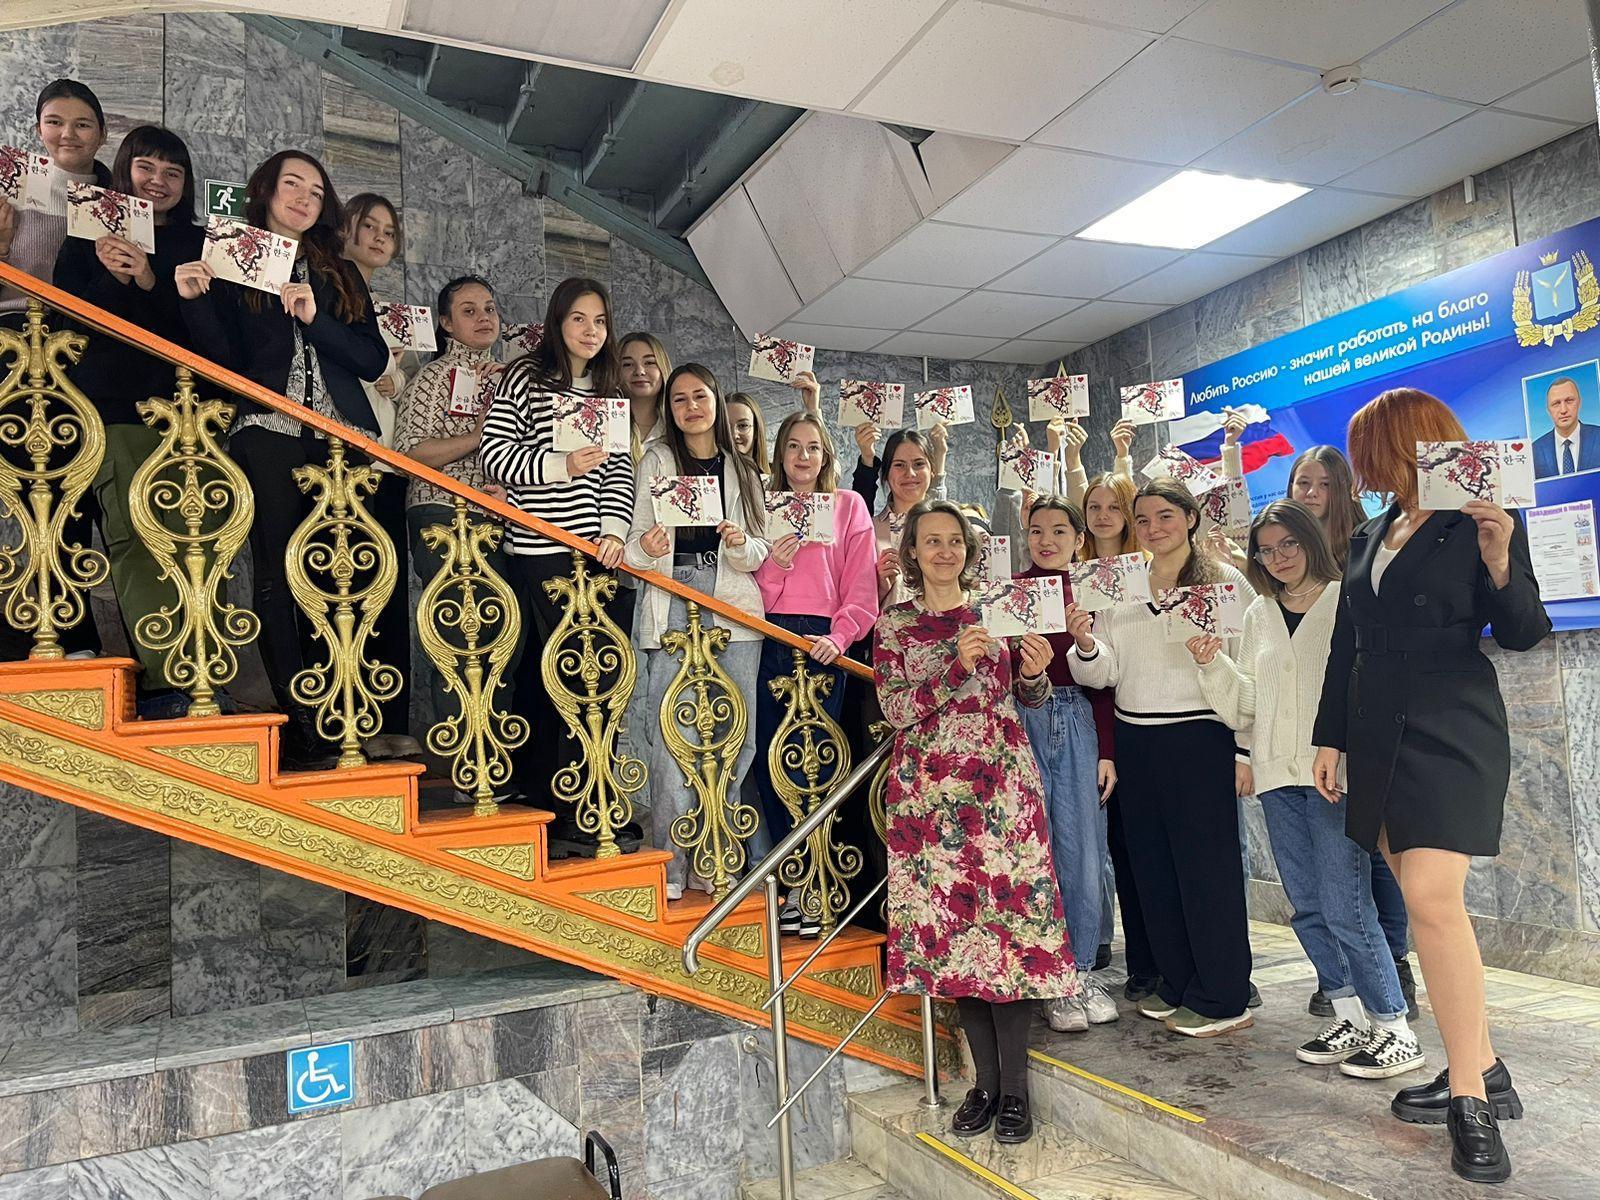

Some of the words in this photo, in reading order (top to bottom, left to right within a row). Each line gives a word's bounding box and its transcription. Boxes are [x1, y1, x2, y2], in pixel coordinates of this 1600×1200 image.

[133, 210, 149, 219] 한국
[274, 249, 290, 260] 한국
[1190, 384, 1229, 406] Любить
[1231, 365, 1278, 390] Россию
[1289, 345, 1334, 370] значит
[1338, 321, 1408, 357] работать
[1412, 310, 1434, 328] на
[1438, 292, 1489, 319] благо
[1303, 358, 1351, 386] нашей
[1354, 336, 1417, 369] великой
[1421, 311, 1491, 348] Родины!
[611, 410, 626, 419] 한국
[1503, 454, 1527, 466] 한국
[816, 503, 830, 511] 한국
[1043, 589, 1059, 598] 한국
[1219, 594, 1236, 604] 한국
